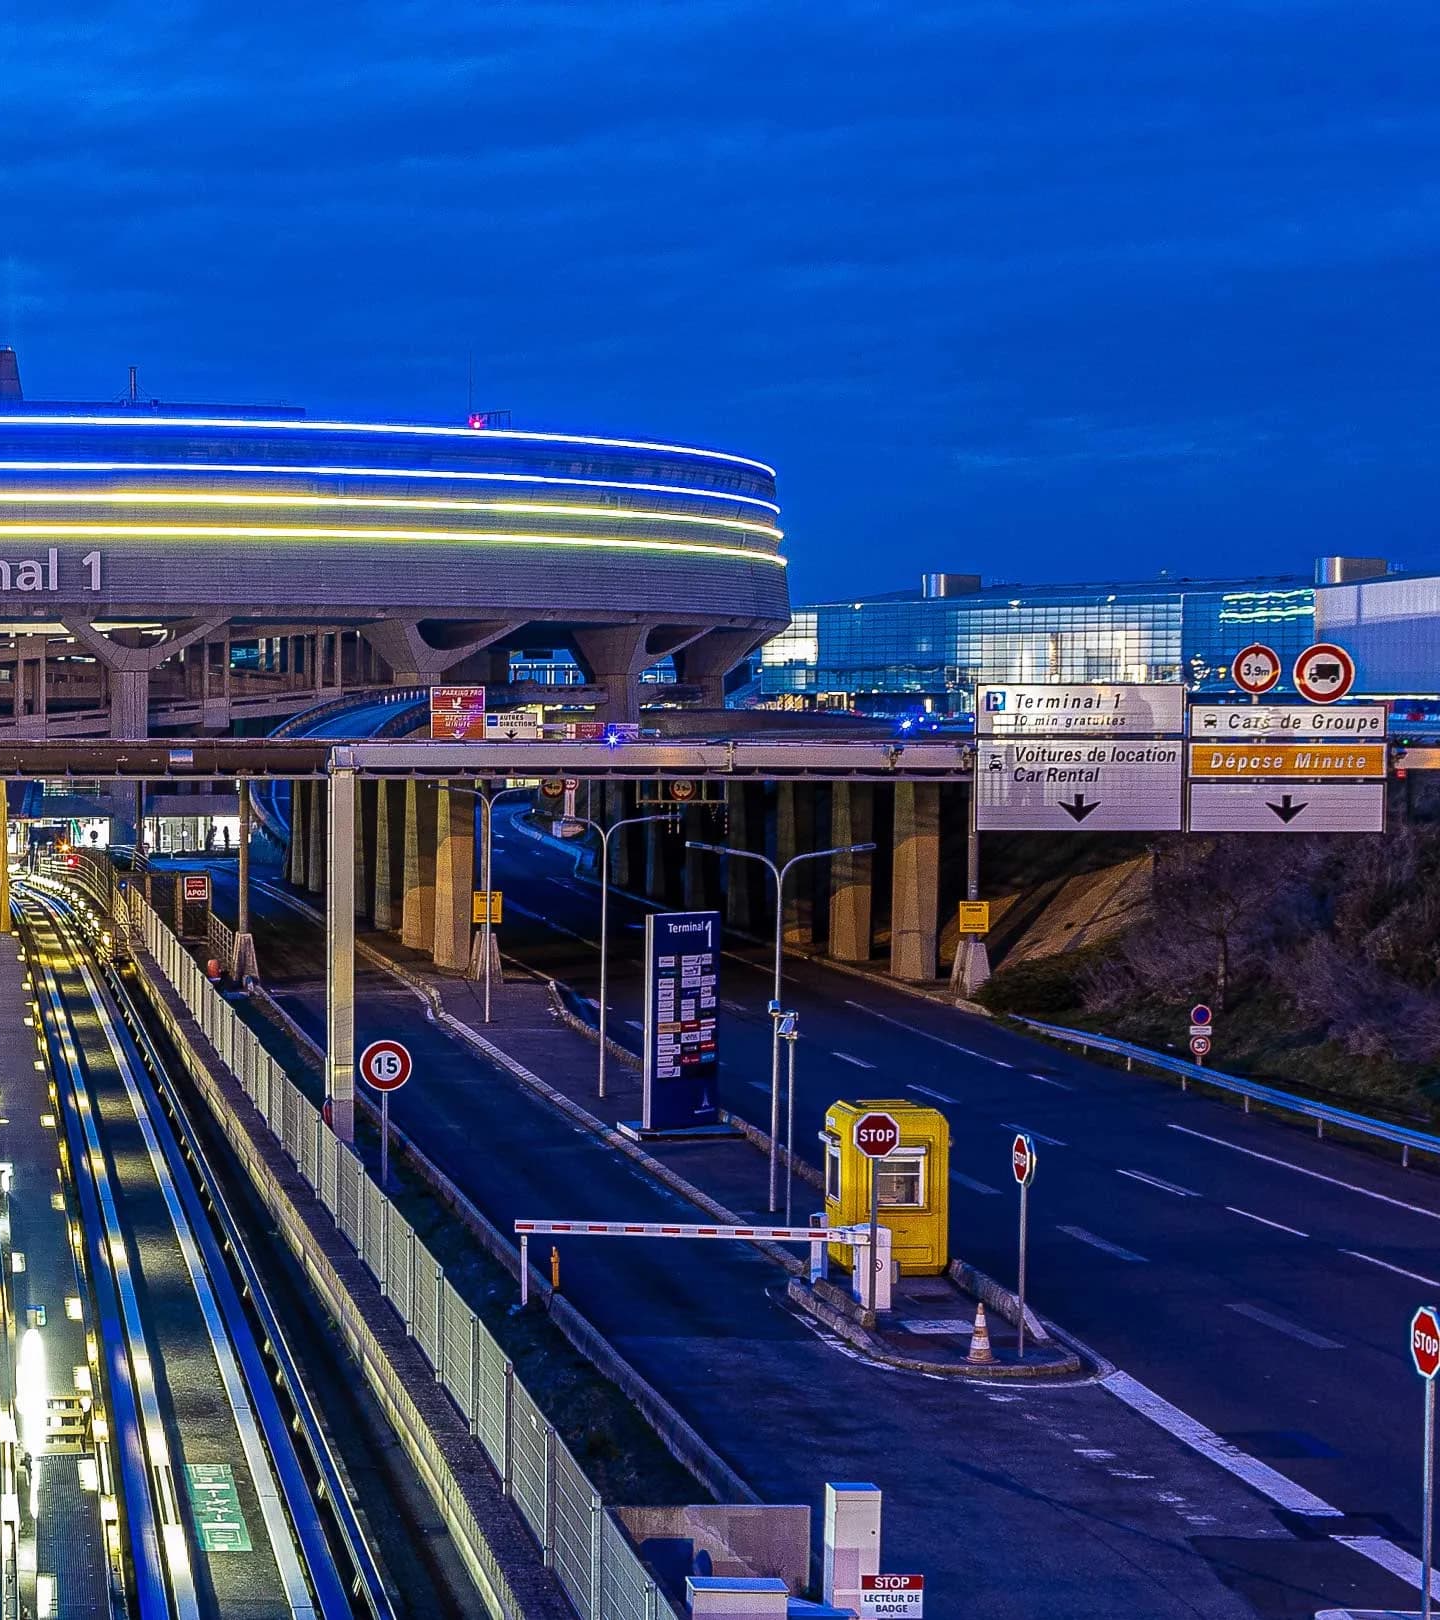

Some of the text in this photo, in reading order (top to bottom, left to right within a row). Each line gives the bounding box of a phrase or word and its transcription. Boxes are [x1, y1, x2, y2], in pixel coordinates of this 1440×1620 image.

[82, 551, 101, 591] 1
[1015, 693, 1101, 709] Terminal
[1113, 694, 1122, 709] 1
[1014, 715, 1126, 728] 10 min gratuites
[1228, 714, 1379, 733] Cars de Groupe
[1016, 747, 1176, 762] Voitures de location
[1211, 752, 1367, 772] Dépose Minute
[1014, 767, 1099, 783] Car Rental
[667, 920, 712, 947] Terminal 1
[375, 1057, 398, 1074] 15
[860, 1129, 895, 1142] STOP
[1414, 1330, 1439, 1356] STOP
[874, 1577, 910, 1588] STOP
[863, 1594, 920, 1603] LECTEUR DE
[875, 1604, 908, 1613] BADGE
